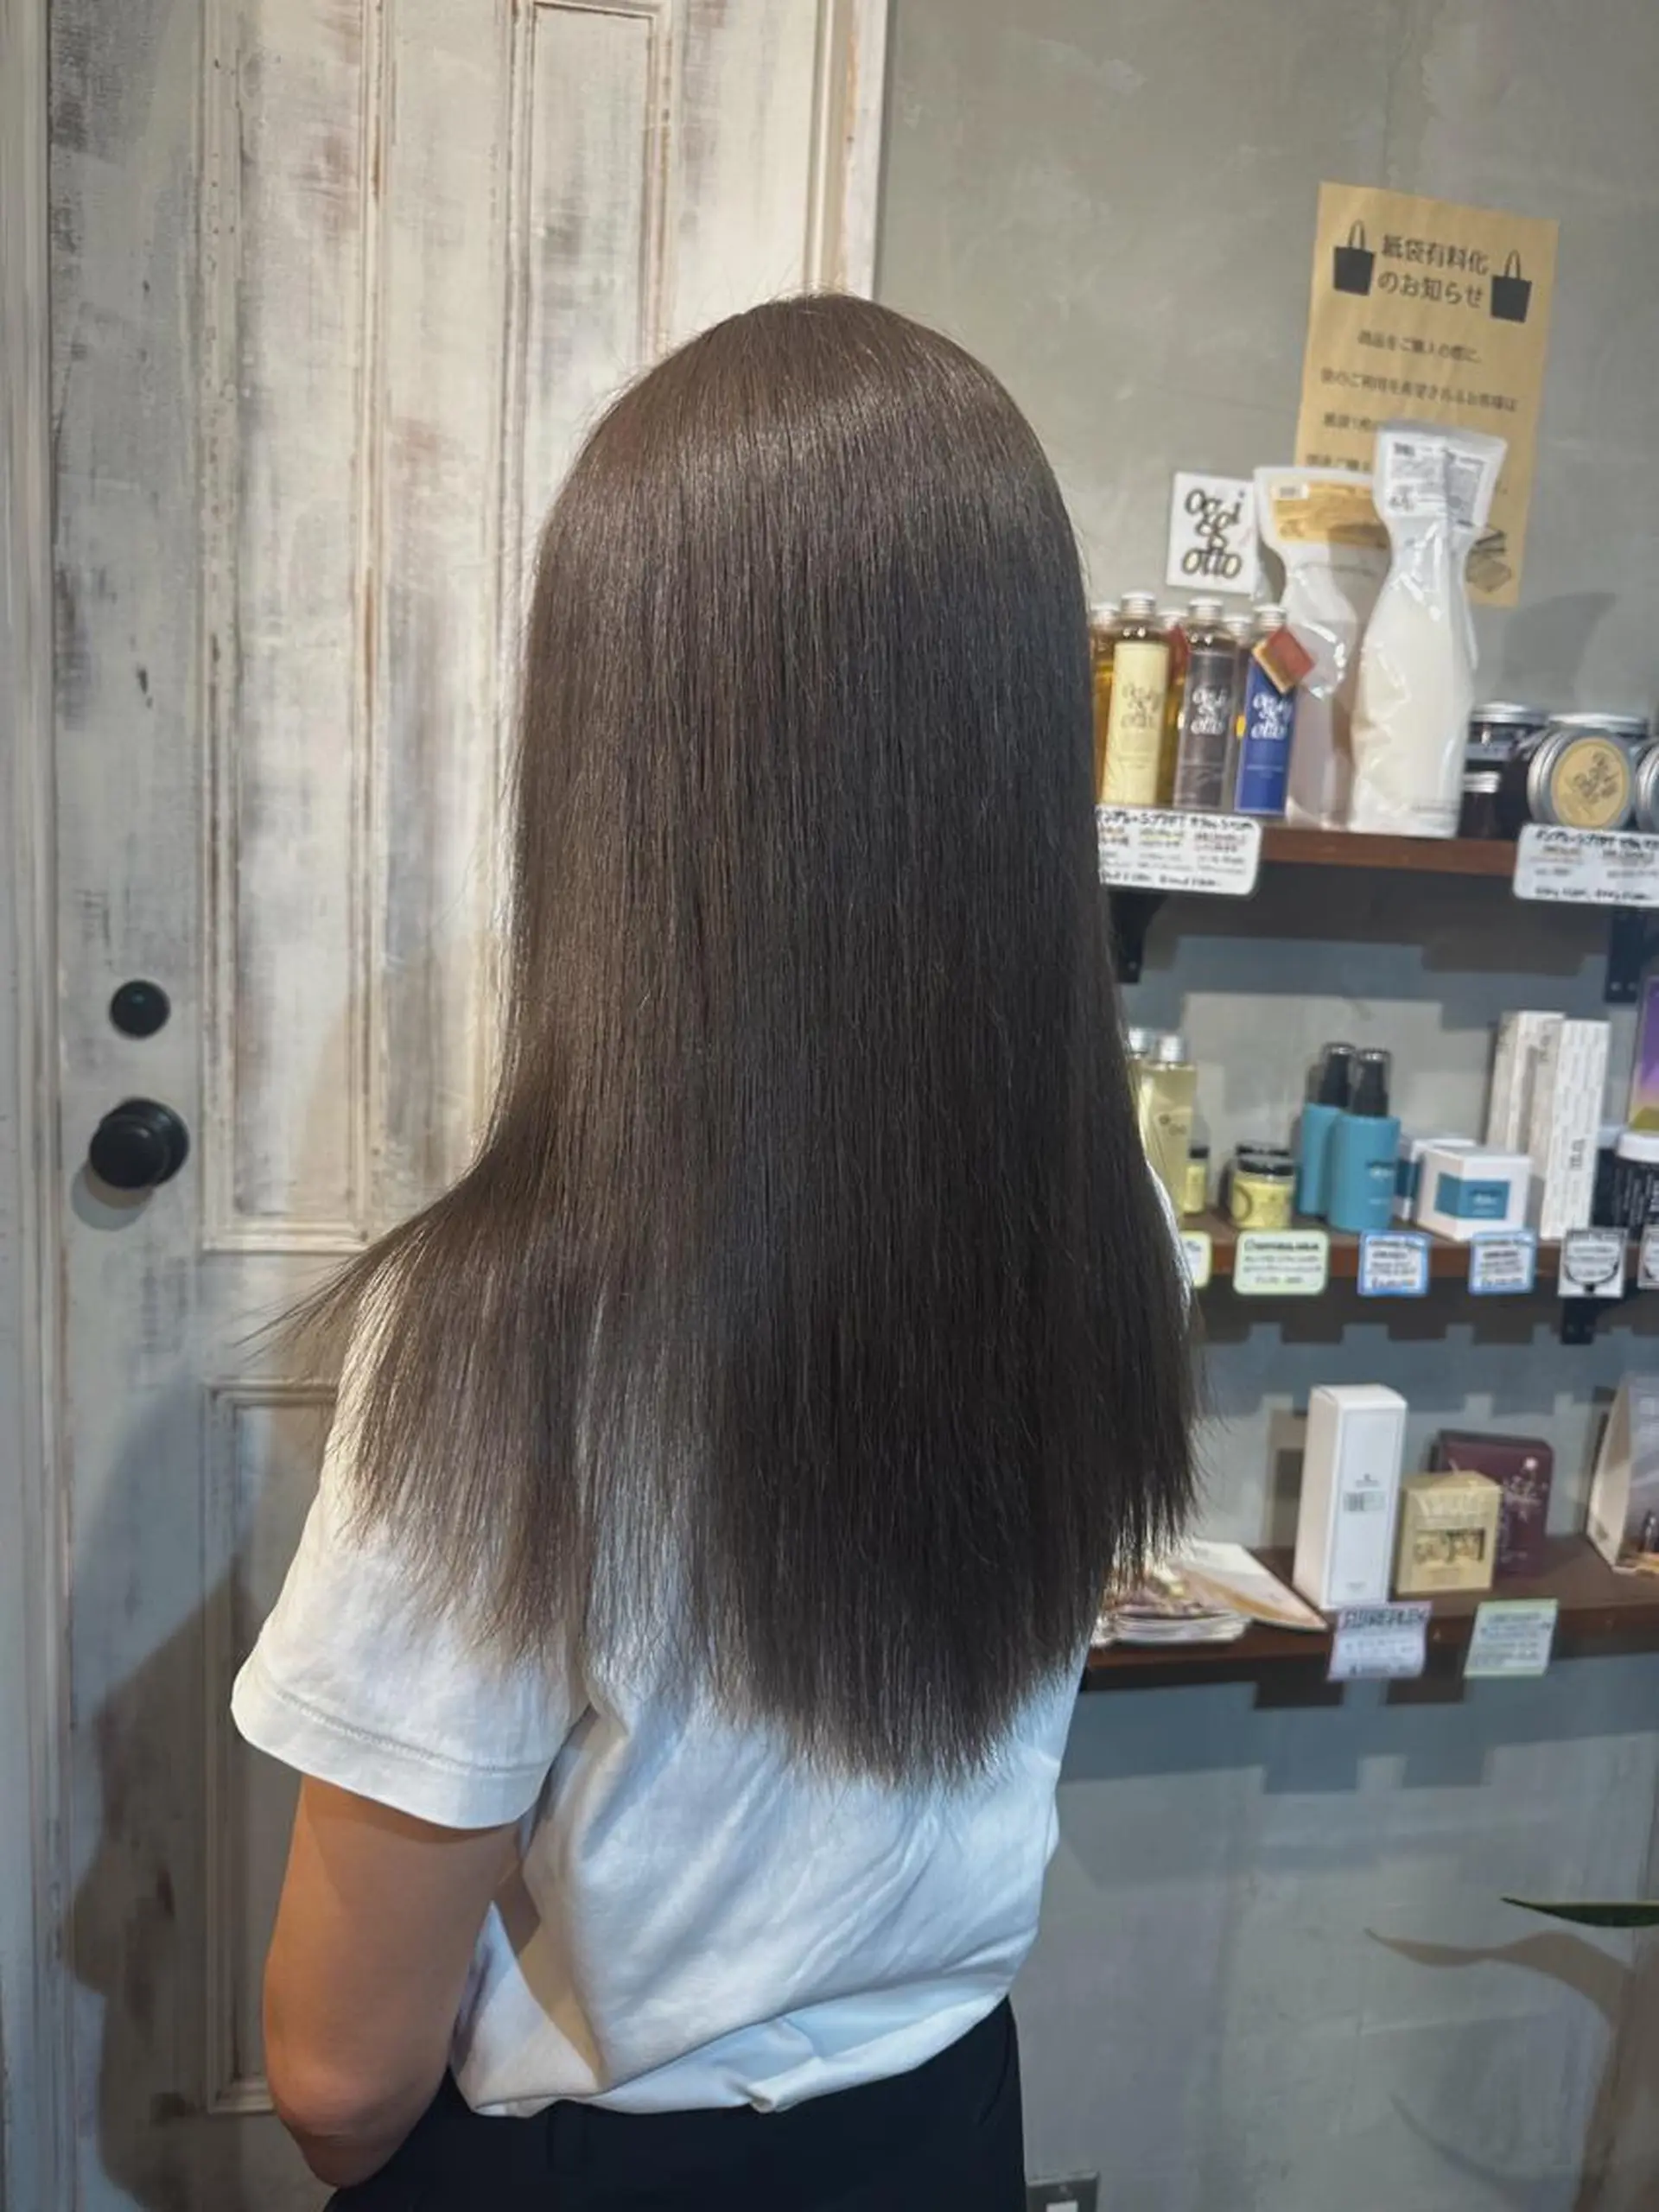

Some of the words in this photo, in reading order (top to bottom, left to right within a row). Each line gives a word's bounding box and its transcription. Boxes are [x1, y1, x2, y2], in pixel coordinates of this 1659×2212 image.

[1382, 234, 1489, 276] 紙袋有料化
[1377, 271, 1483, 308] のお知らせ
